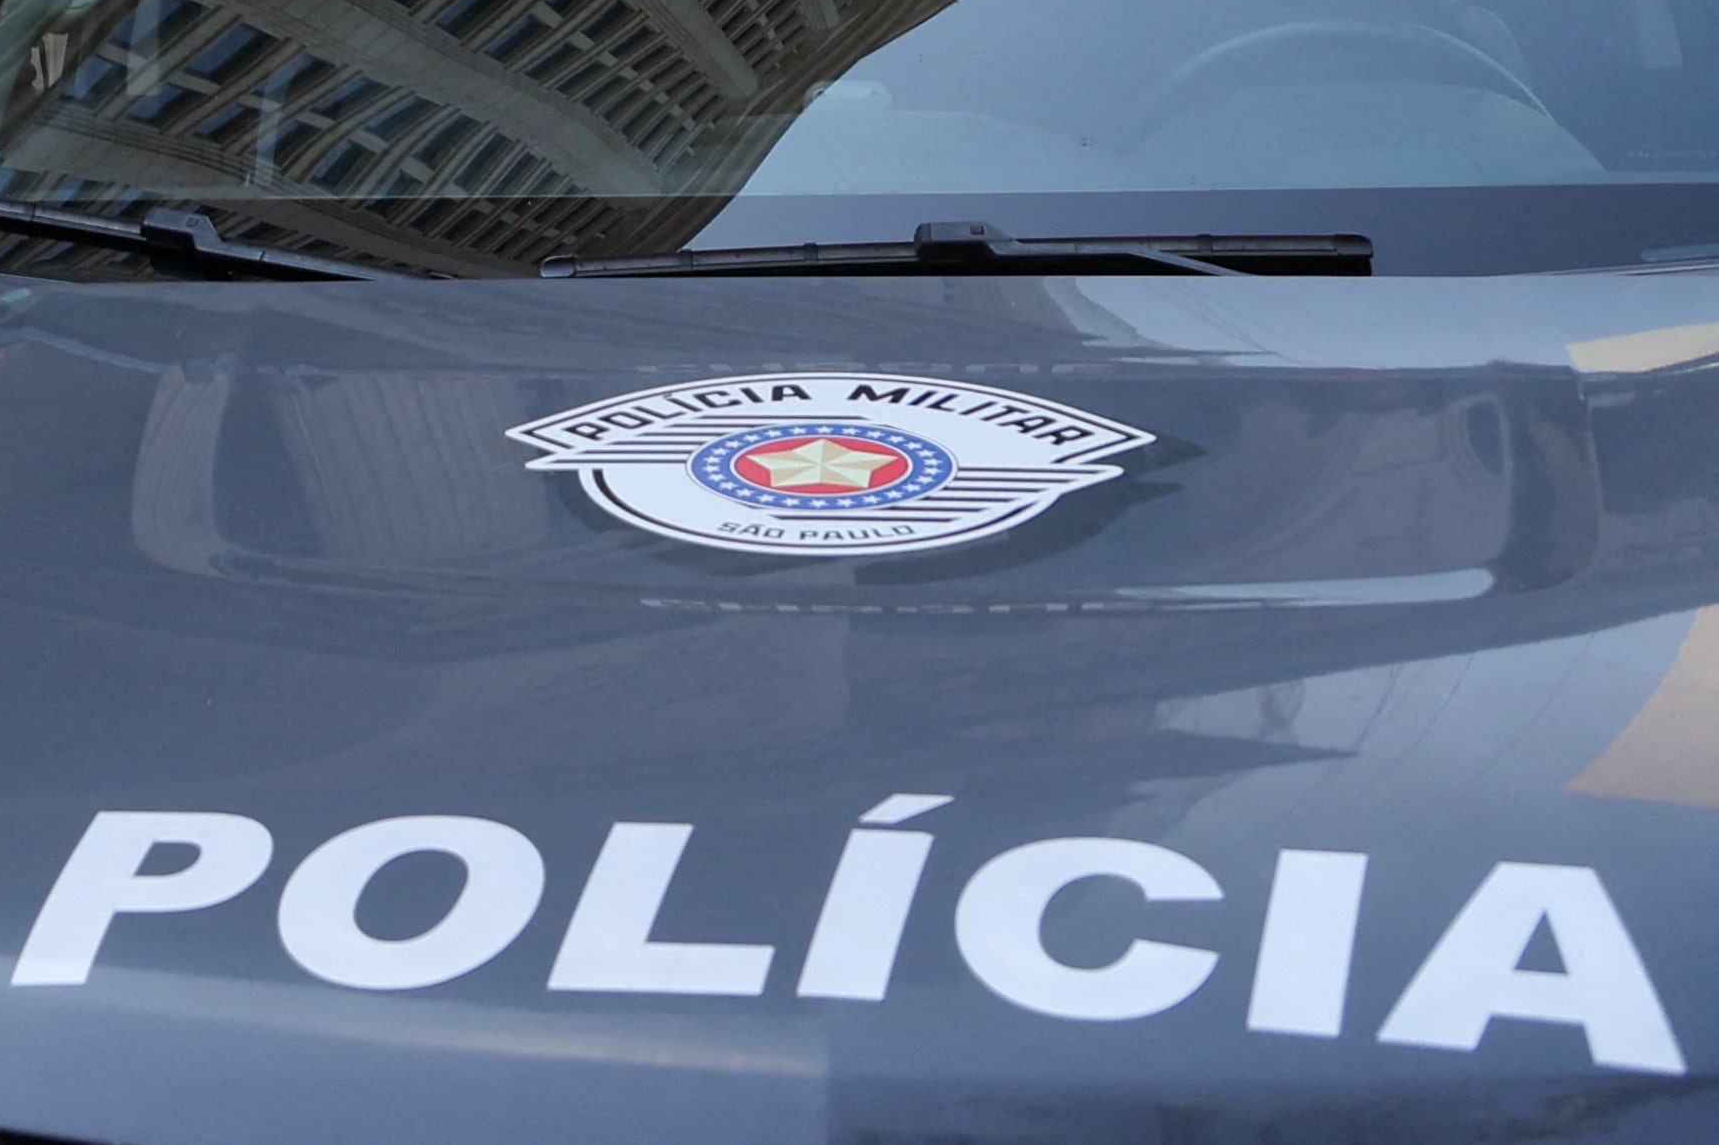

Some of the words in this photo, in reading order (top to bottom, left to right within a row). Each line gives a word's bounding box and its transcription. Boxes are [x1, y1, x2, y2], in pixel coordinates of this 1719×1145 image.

[563, 383, 812, 440] POLÍCIA
[846, 383, 1093, 447] MILITAR
[715, 521, 785, 539] SÃO
[799, 523, 917, 541] PAULO
[10, 793, 1687, 1075] POLÍCIA
